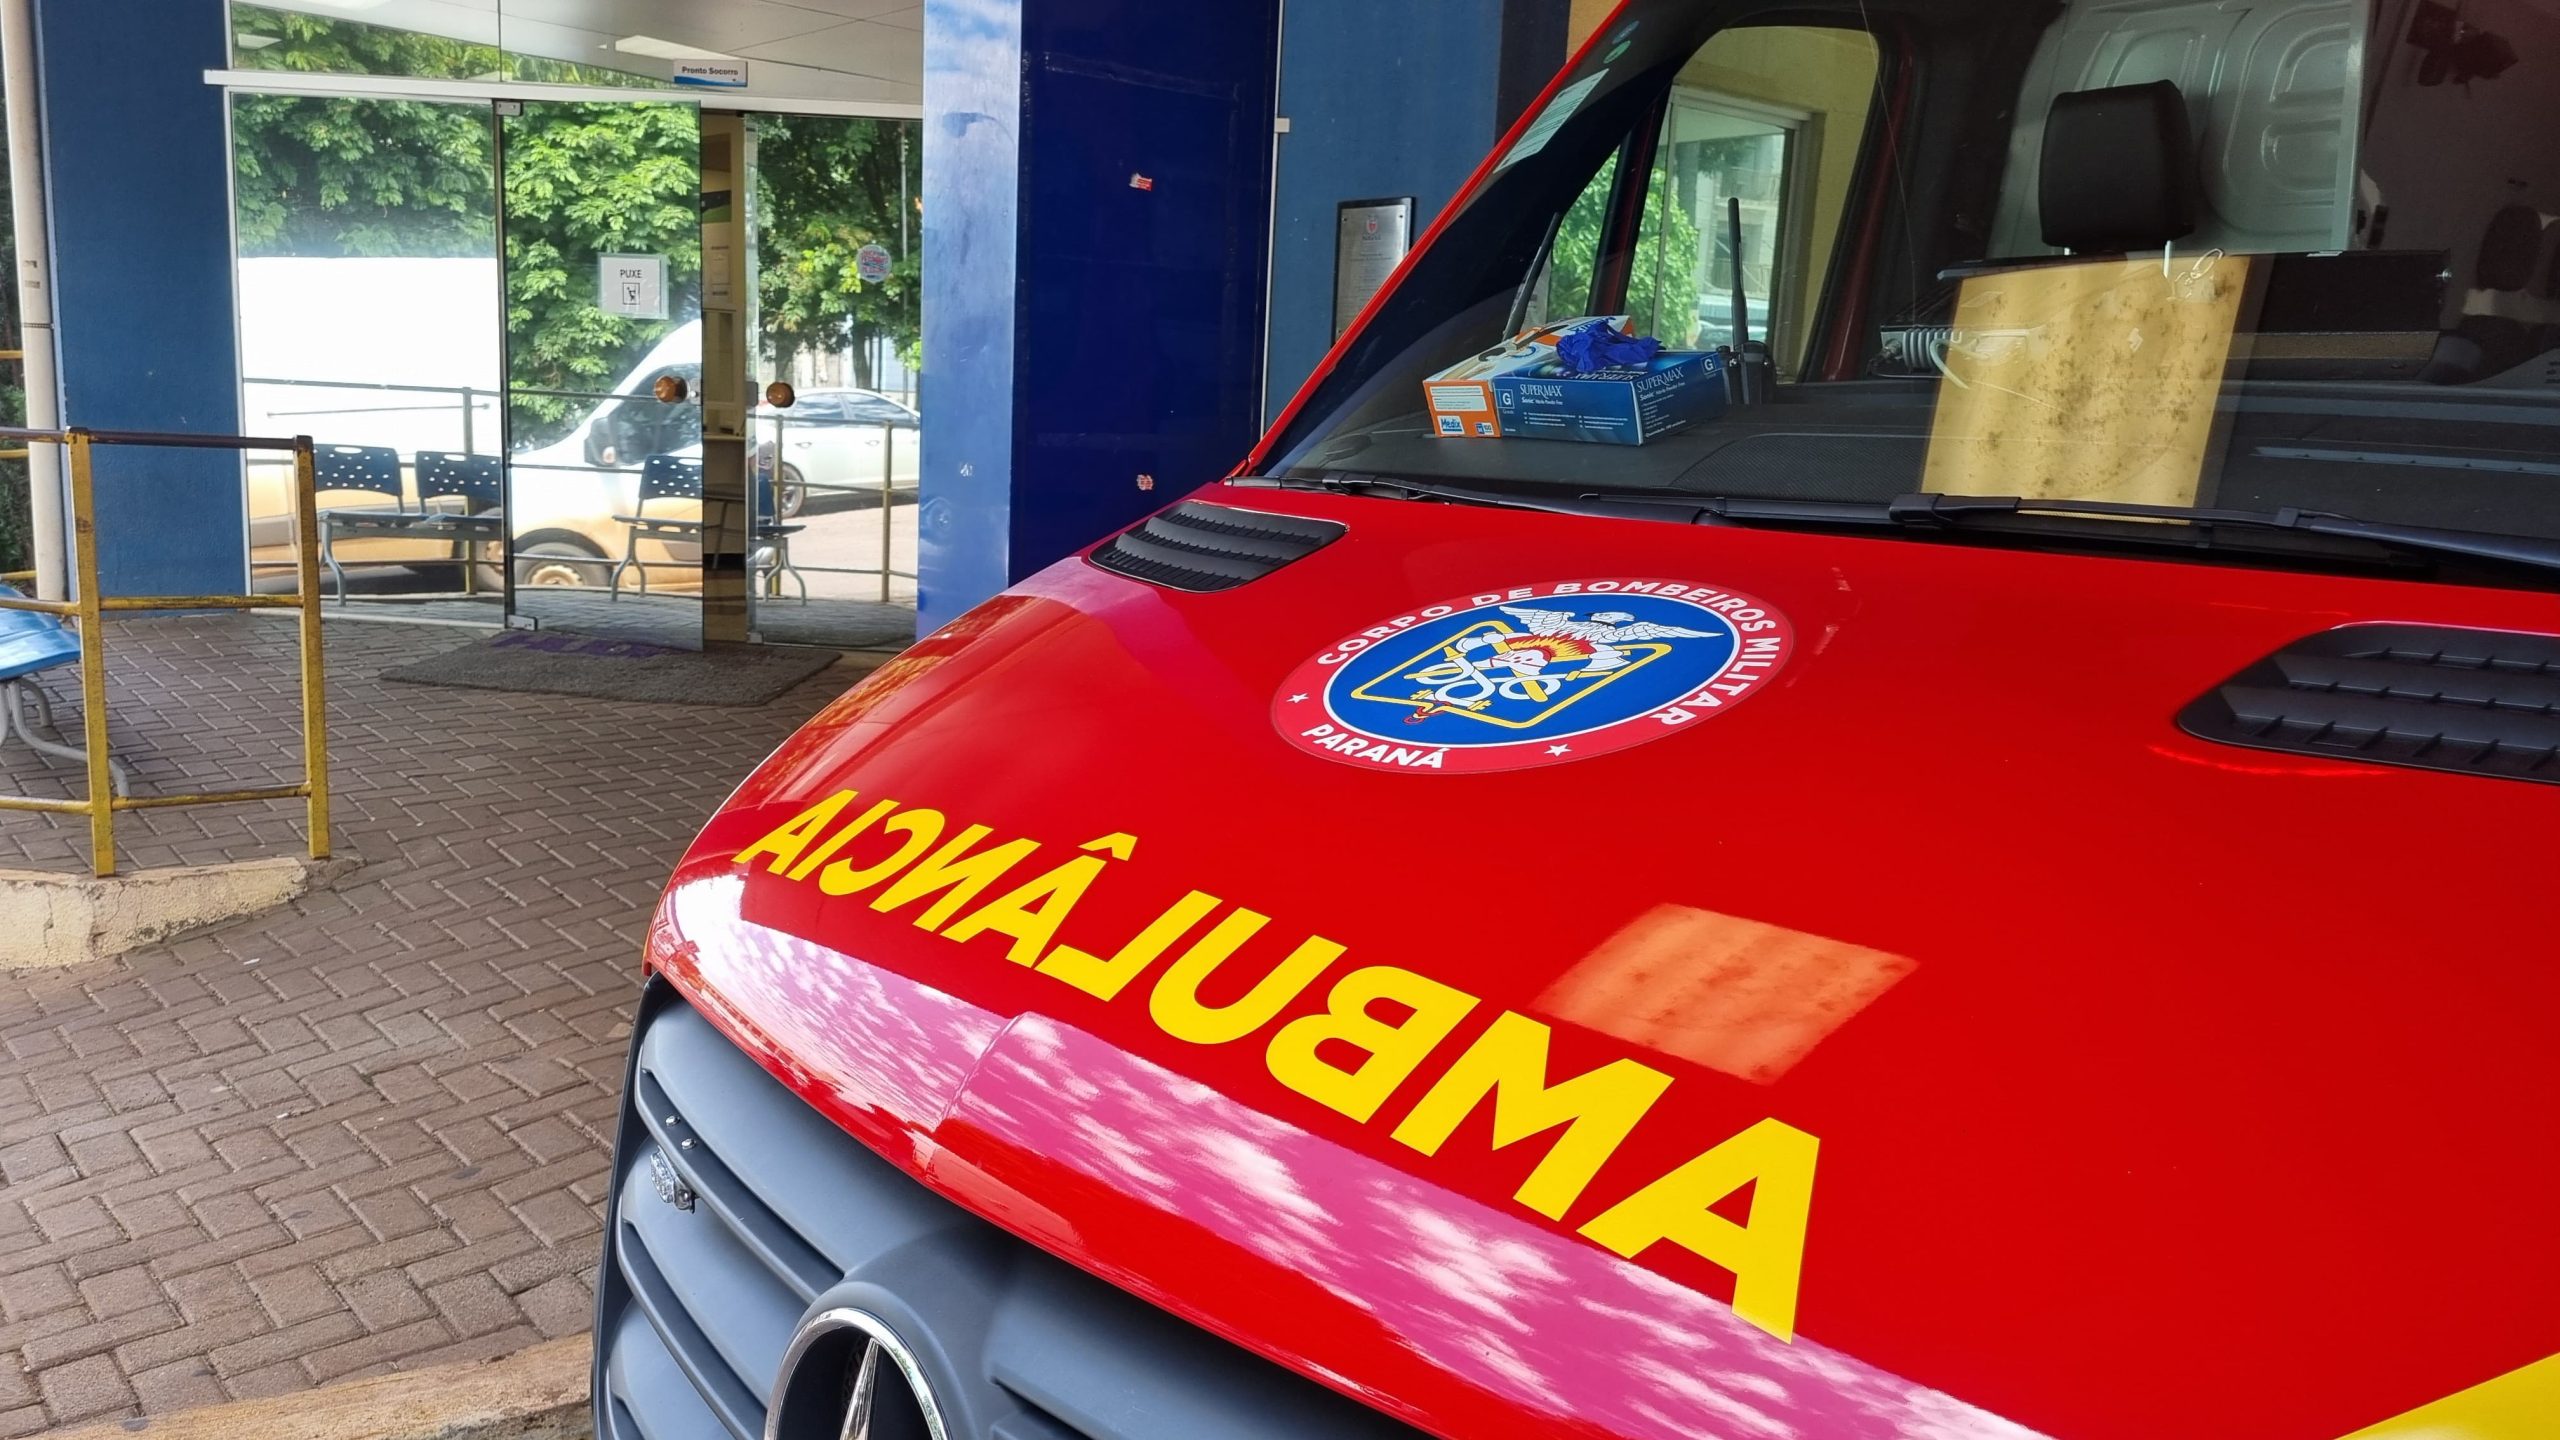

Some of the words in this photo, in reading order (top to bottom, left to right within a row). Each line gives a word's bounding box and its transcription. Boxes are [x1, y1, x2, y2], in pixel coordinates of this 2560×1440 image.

[682, 66, 707, 74] Pronto
[708, 67, 738, 75] Socorro
[620, 269, 642, 278] PUXE
[1704, 359, 1714, 371] G
[1636, 367, 1684, 393] SUPERMAX
[1502, 392, 1512, 405] G
[1520, 383, 1563, 399] SUPERMAX
[1471, 587, 1533, 606] DE
[1552, 581, 1776, 632] BOMBEIROS
[1317, 605, 1453, 665] CORPO
[1649, 637, 1781, 725] MILITAR
[1301, 724, 1451, 768] PARANÁ
